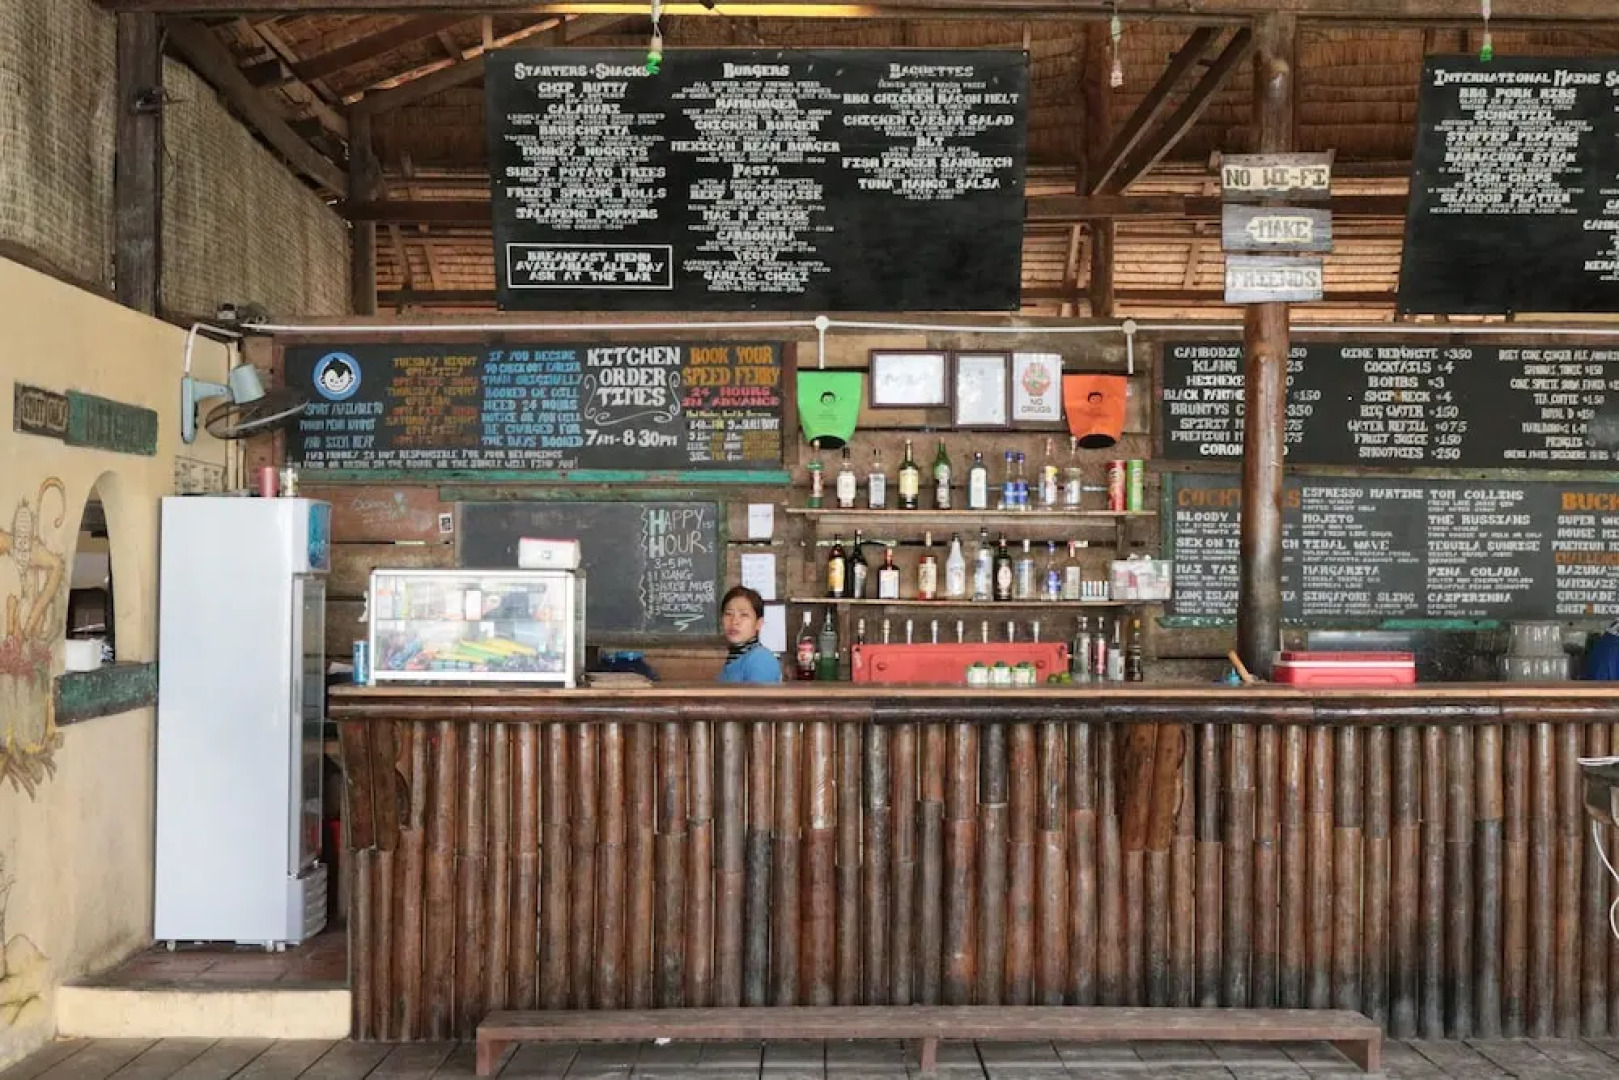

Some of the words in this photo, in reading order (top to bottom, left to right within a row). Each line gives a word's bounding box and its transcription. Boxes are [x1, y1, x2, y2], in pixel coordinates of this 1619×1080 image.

[1433, 70, 1551, 86] INTERNATIONAL
[538, 82, 574, 93] CHIP
[583, 82, 629, 93] BUTTY
[1459, 88, 1488, 98] BBQ
[1495, 88, 1533, 98] PORK
[1540, 88, 1577, 98] RIBS
[715, 99, 798, 109] HAMBURGER
[843, 93, 869, 104] BBQ
[873, 93, 934, 104] CHICKEN
[938, 93, 981, 104] BACON
[984, 93, 1019, 104] MELT
[548, 104, 621, 114] CALAMARI
[843, 115, 906, 126] CHICKEN
[910, 115, 965, 126] CAESAR
[968, 115, 1014, 126] SALAD
[1473, 110, 1556, 120] SCHNITZEL
[539, 125, 630, 135] BRUSCHETTA
[694, 120, 758, 130] CHICKEN
[765, 120, 819, 131] BURGER
[916, 137, 944, 147] BLT
[1446, 132, 1509, 142] STUFFED
[1516, 132, 1580, 142] PEPPERS
[523, 146, 577, 156] MONKEY
[584, 146, 648, 156] NUGGETS
[671, 141, 735, 152] MEXICAN
[743, 141, 780, 152] BEAN
[786, 141, 840, 152] BURGER
[842, 157, 879, 168] FISH
[883, 157, 937, 168] FINGER
[940, 157, 1012, 168] SANDWICH
[1444, 152, 1524, 162] BARRACUDA
[1531, 152, 1577, 162] STEAK
[506, 167, 550, 177] SWEET
[559, 167, 613, 177] POTATO
[621, 167, 666, 178] FRIES
[1226, 169, 1250, 187] NO
[1263, 169, 1327, 187] WI-FI
[1464, 172, 1500, 182] FISH
[1508, 172, 1553, 182] CHIPS
[858, 178, 893, 189] TUNA
[902, 178, 947, 189] MANGO
[955, 178, 1000, 189] SALSA
[506, 188, 552, 198] FRIED
[560, 188, 613, 198] SPRING
[621, 188, 667, 198] ROLLS
[690, 190, 725, 200] BEEF
[734, 190, 822, 200] BOLOGNAISE
[1440, 193, 1503, 203] SEAFOOD
[1510, 193, 1571, 203] PLATTER
[516, 209, 587, 219] JALAPENO
[596, 209, 658, 219] POPPERS
[703, 210, 730, 220] MAC
[739, 210, 748, 220] N
[756, 210, 809, 220] CHEESE
[1258, 219, 1308, 239] MAKE
[716, 231, 796, 241] CARBONARA
[527, 251, 607, 262] BREAKFAST
[615, 252, 651, 262] MENU
[515, 261, 594, 271] AVAILABLE
[602, 262, 628, 272] ALL
[637, 262, 664, 273] DAY
[529, 271, 556, 281] ASK
[563, 271, 581, 281] AT
[589, 272, 617, 282] THE
[625, 272, 651, 282] BAR
[703, 272, 756, 281] GARLIC
[765, 272, 809, 282] CHILI
[1231, 270, 1317, 288] FRIENDS
[489, 350, 504, 362] IF
[509, 350, 529, 362] YOU
[587, 346, 681, 367] KITCHEN
[690, 347, 729, 364] BOOK
[737, 346, 772, 363] YOUR
[1192, 360, 1237, 373] KLANG
[1364, 361, 1431, 374] COCKTAILS
[599, 367, 667, 386] ORDER
[683, 366, 730, 386] SPEED
[735, 366, 780, 386] FERRY
[1186, 375, 1244, 386] HEINEKE
[1368, 376, 1418, 388] BOMBS
[486, 387, 526, 398] BOOKED
[596, 386, 666, 407] TIMES
[691, 387, 711, 397] 24
[719, 386, 770, 396] HOURS
[1164, 389, 1198, 400] BLACK
[541, 400, 578, 410] HOURS
[682, 397, 702, 408] IN
[712, 396, 779, 407] ADVANCE
[1171, 403, 1229, 416] BRUNTYS
[1360, 404, 1384, 420] BIG
[1386, 404, 1423, 418] WATER
[560, 424, 581, 434] FOR
[1180, 418, 1229, 430] SPIRIT
[1347, 419, 1384, 432] WATER
[1388, 420, 1429, 432] REFILL
[481, 436, 503, 445] THE
[507, 436, 536, 447] DAYS
[542, 436, 583, 447] BOOKED
[1172, 430, 1230, 442] PREMIUM
[1354, 433, 1390, 445] FRUIT
[1394, 433, 1429, 445] JUICE
[399, 450, 459, 459] RESPONSIBLE
[1200, 443, 1243, 456] CORON
[1359, 446, 1423, 458] SMOOTHIES
[1302, 487, 1363, 498] ESPRESSO
[1429, 490, 1456, 499] TOM
[1464, 490, 1525, 500] COLLINS
[1177, 511, 1229, 522] BLOODY
[1302, 514, 1354, 524] MOJITO
[1428, 515, 1455, 525] THE
[1461, 515, 1531, 525] RUSSIANS
[1557, 515, 1596, 525] SUPER
[649, 509, 705, 536] HAPPY
[1557, 528, 1596, 539] HOUSE
[649, 531, 707, 559] HOUR
[1176, 537, 1203, 548] SEX
[1206, 538, 1223, 548] ON
[1302, 540, 1346, 550] TIDAL
[1353, 540, 1390, 550] WAVE
[1427, 540, 1481, 551] TEQUILA
[1487, 540, 1541, 552] SUNRISE
[1552, 540, 1606, 551] PREMIUM
[1176, 564, 1202, 574] MAI
[1210, 564, 1238, 574] TAI
[1302, 565, 1379, 576] MARGARITA
[1427, 567, 1461, 577] PINA
[1470, 567, 1522, 577] COLADA
[1175, 590, 1202, 601] LONG
[1302, 591, 1371, 602] SINGAPORE
[1377, 592, 1415, 603] SLING
[1427, 593, 1513, 603] CAIPIRINHA
[1557, 590, 1616, 601] GRENADE
